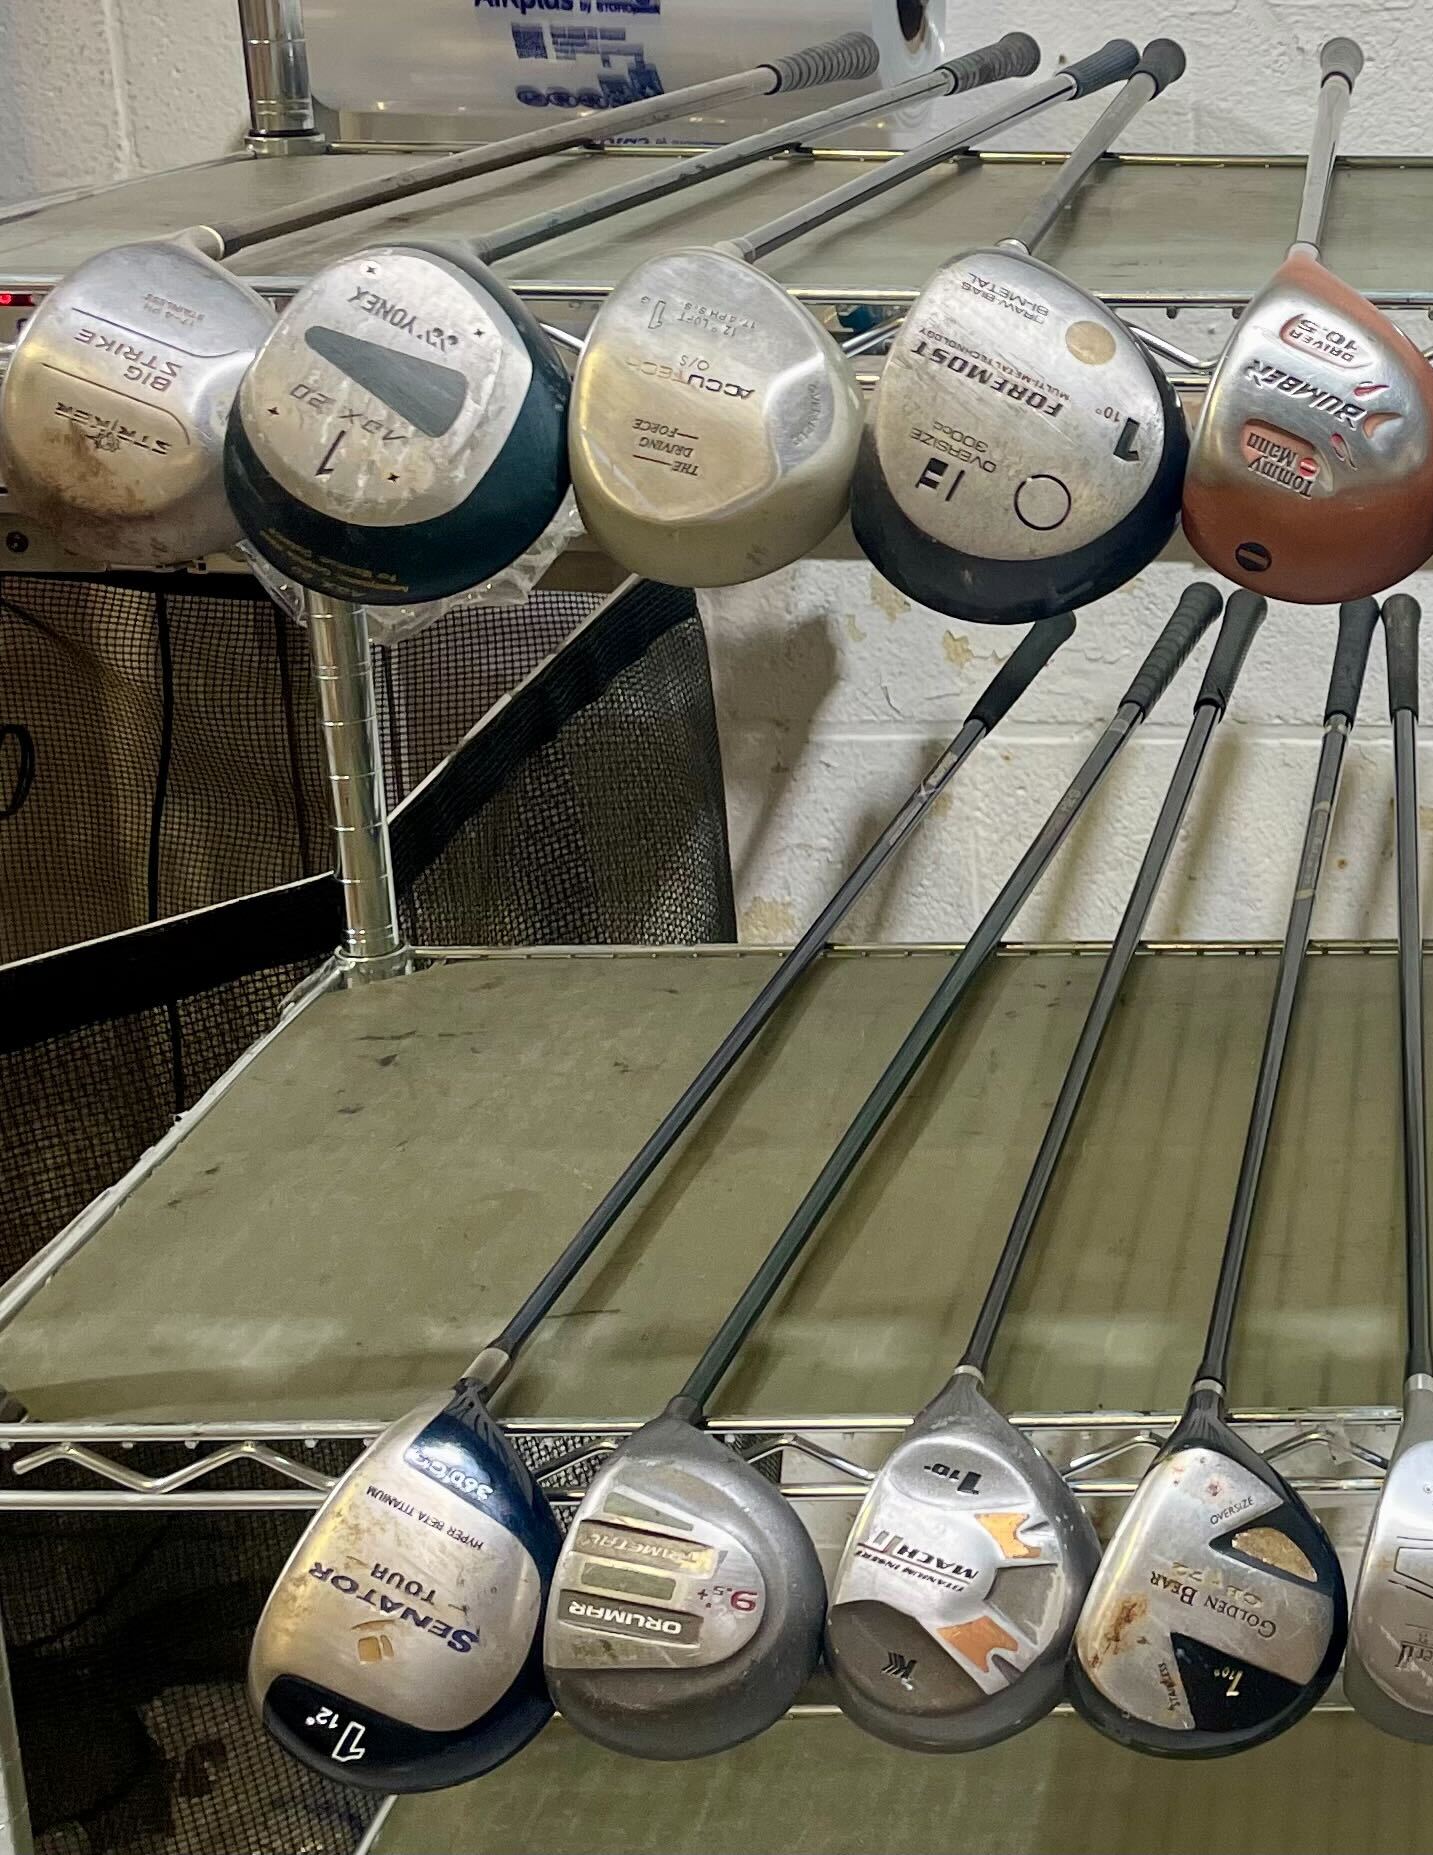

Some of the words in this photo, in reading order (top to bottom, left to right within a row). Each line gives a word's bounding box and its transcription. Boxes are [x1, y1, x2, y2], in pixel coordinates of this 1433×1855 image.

[346, 285, 418, 333] YONEX
[72, 326, 182, 377] STRIKE
[917, 326, 993, 365] TECHNOLOGY
[1287, 327, 1353, 364] DRIVER
[122, 363, 172, 392] BIG
[909, 339, 1063, 417] FOREMOST
[52, 400, 172, 455] STRIKER
[631, 417, 678, 437] FORCE
[930, 419, 989, 453] 300cc
[1110, 417, 1141, 463] 1
[312, 429, 346, 481] 1
[637, 436, 693, 457] DRIVING
[908, 426, 997, 474] OVERSIZE
[1243, 431, 1298, 469] Mann
[670, 460, 699, 476] THE
[1246, 452, 1313, 500] Tommy
[365, 1484, 415, 1517] TITANIUM
[1209, 1495, 1254, 1524] OVERSIZE
[416, 1509, 445, 1531] BETA
[446, 1524, 483, 1550] HYPER
[855, 1550, 900, 1569] INSERT
[897, 1545, 978, 1578] MACH
[901, 1565, 964, 1591] TITANIUM
[369, 1561, 436, 1605] TOUR
[1147, 1570, 1198, 1606] BEAR
[306, 1559, 479, 1654] SENATOR
[568, 1601, 680, 1634] ORLIMAR
[1202, 1594, 1277, 1640] GOLDEN
[330, 1719, 371, 1766] 1
